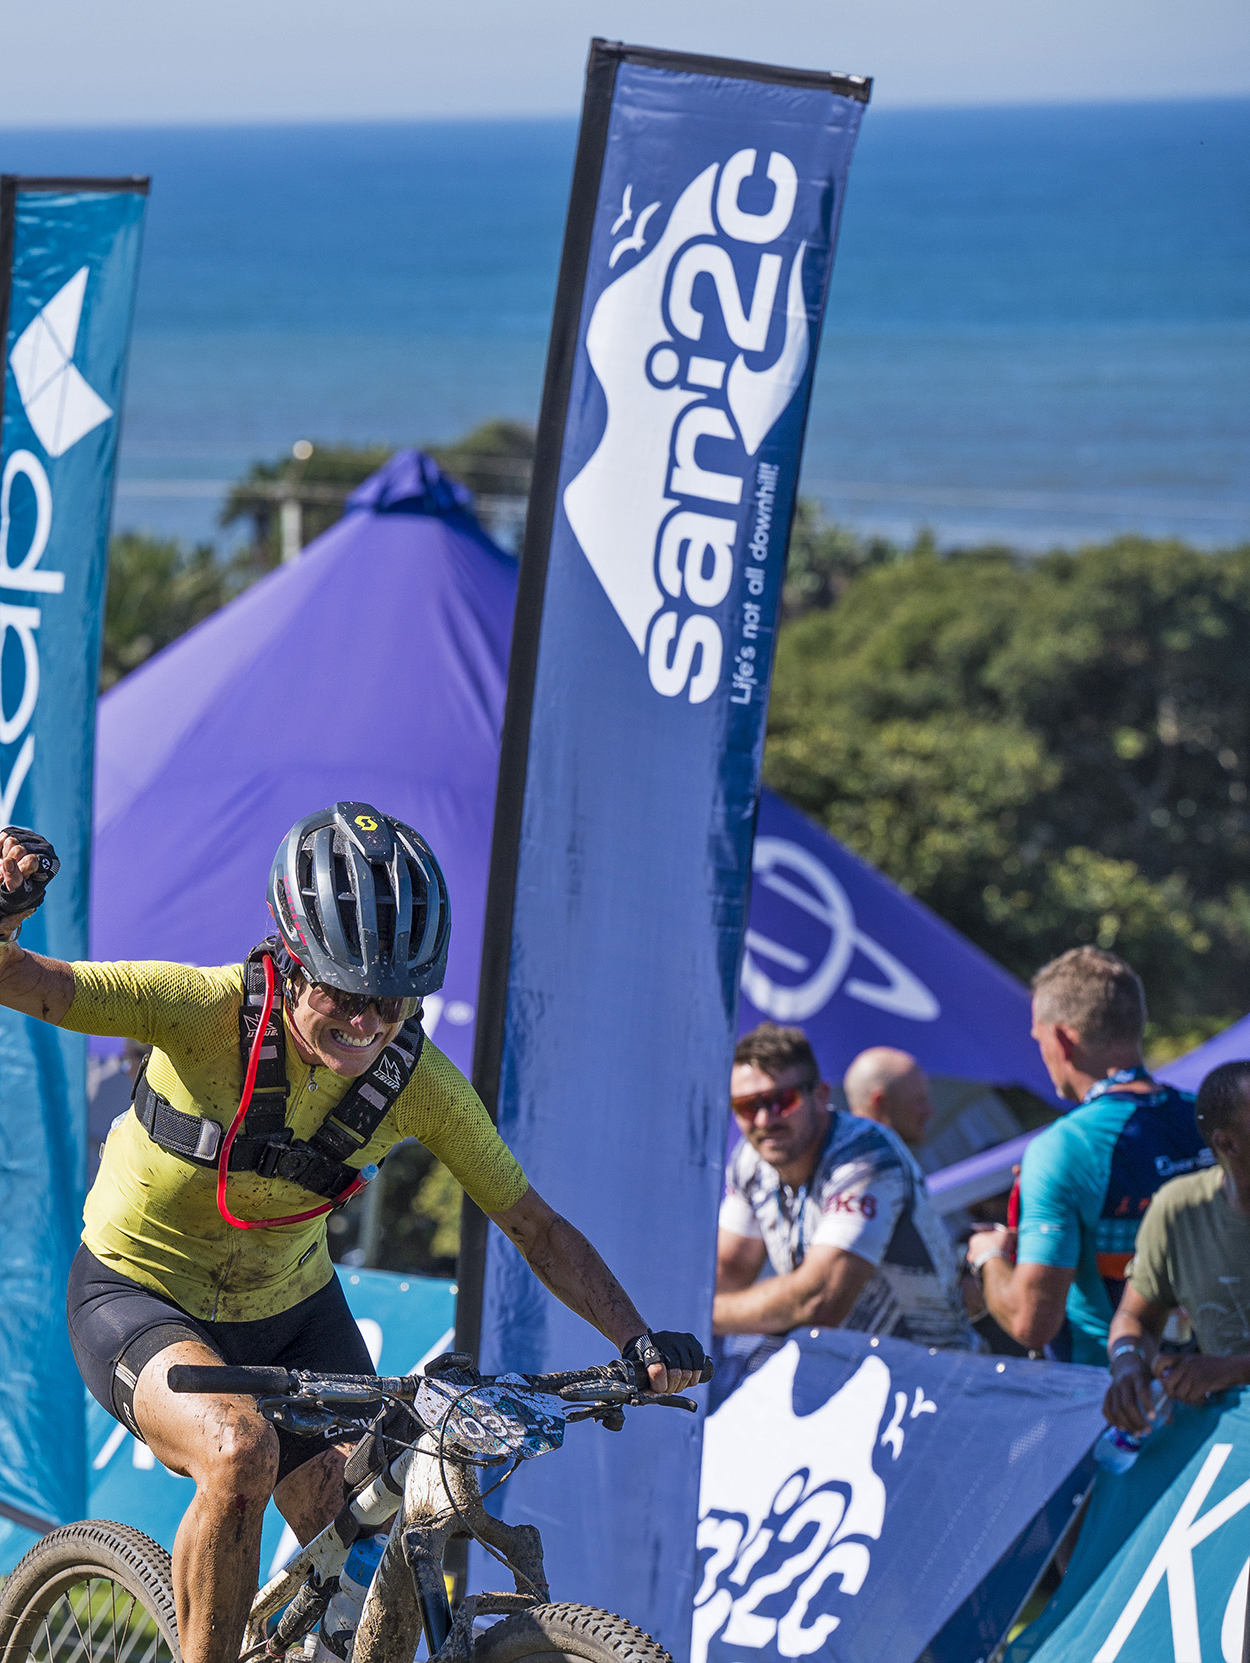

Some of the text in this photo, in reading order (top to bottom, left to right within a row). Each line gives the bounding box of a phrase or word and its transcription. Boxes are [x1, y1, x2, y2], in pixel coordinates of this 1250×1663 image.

[648, 148, 798, 703] sani2c
[729, 462, 779, 706] Life's not all downhill!
